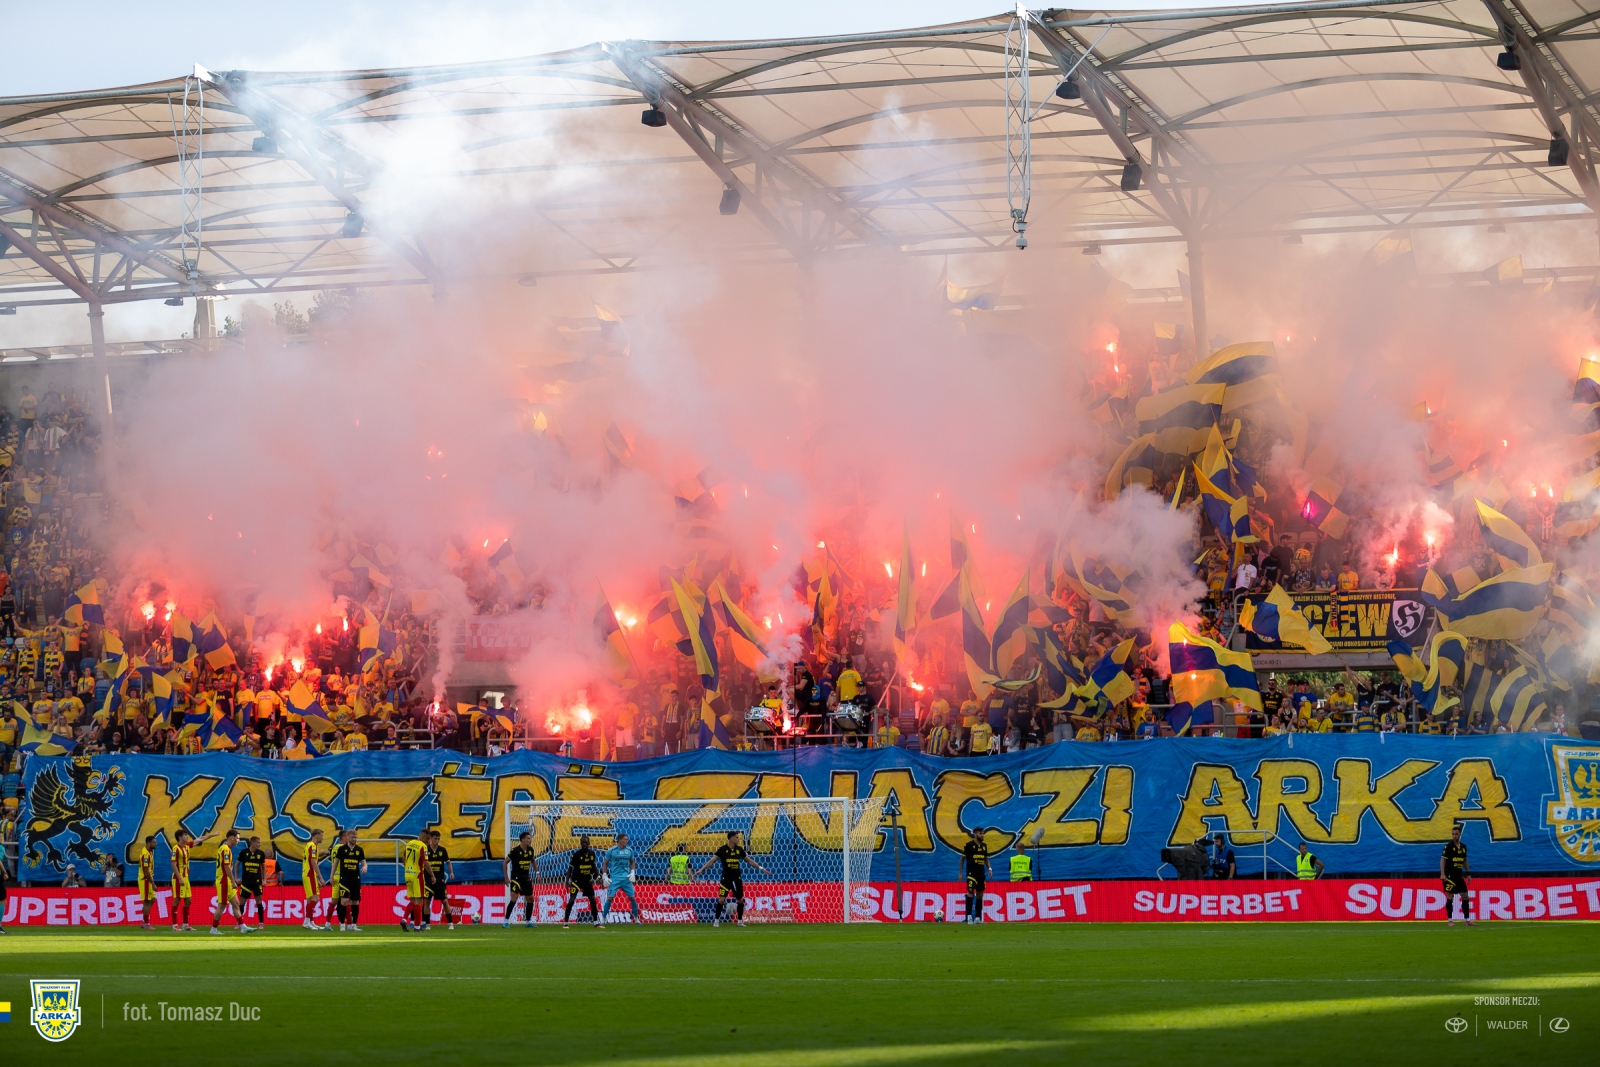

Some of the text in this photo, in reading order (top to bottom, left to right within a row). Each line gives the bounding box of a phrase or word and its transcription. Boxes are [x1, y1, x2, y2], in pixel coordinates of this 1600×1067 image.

[643, 764, 1136, 857] ZNACZI
[1167, 758, 1523, 847] ARKA
[406, 847, 417, 865] 71
[1445, 883, 1454, 892] 27
[852, 884, 1092, 923] SUPERBET
[1133, 889, 1302, 916] SUPERBET
[641, 909, 695, 922] SUPERBET
